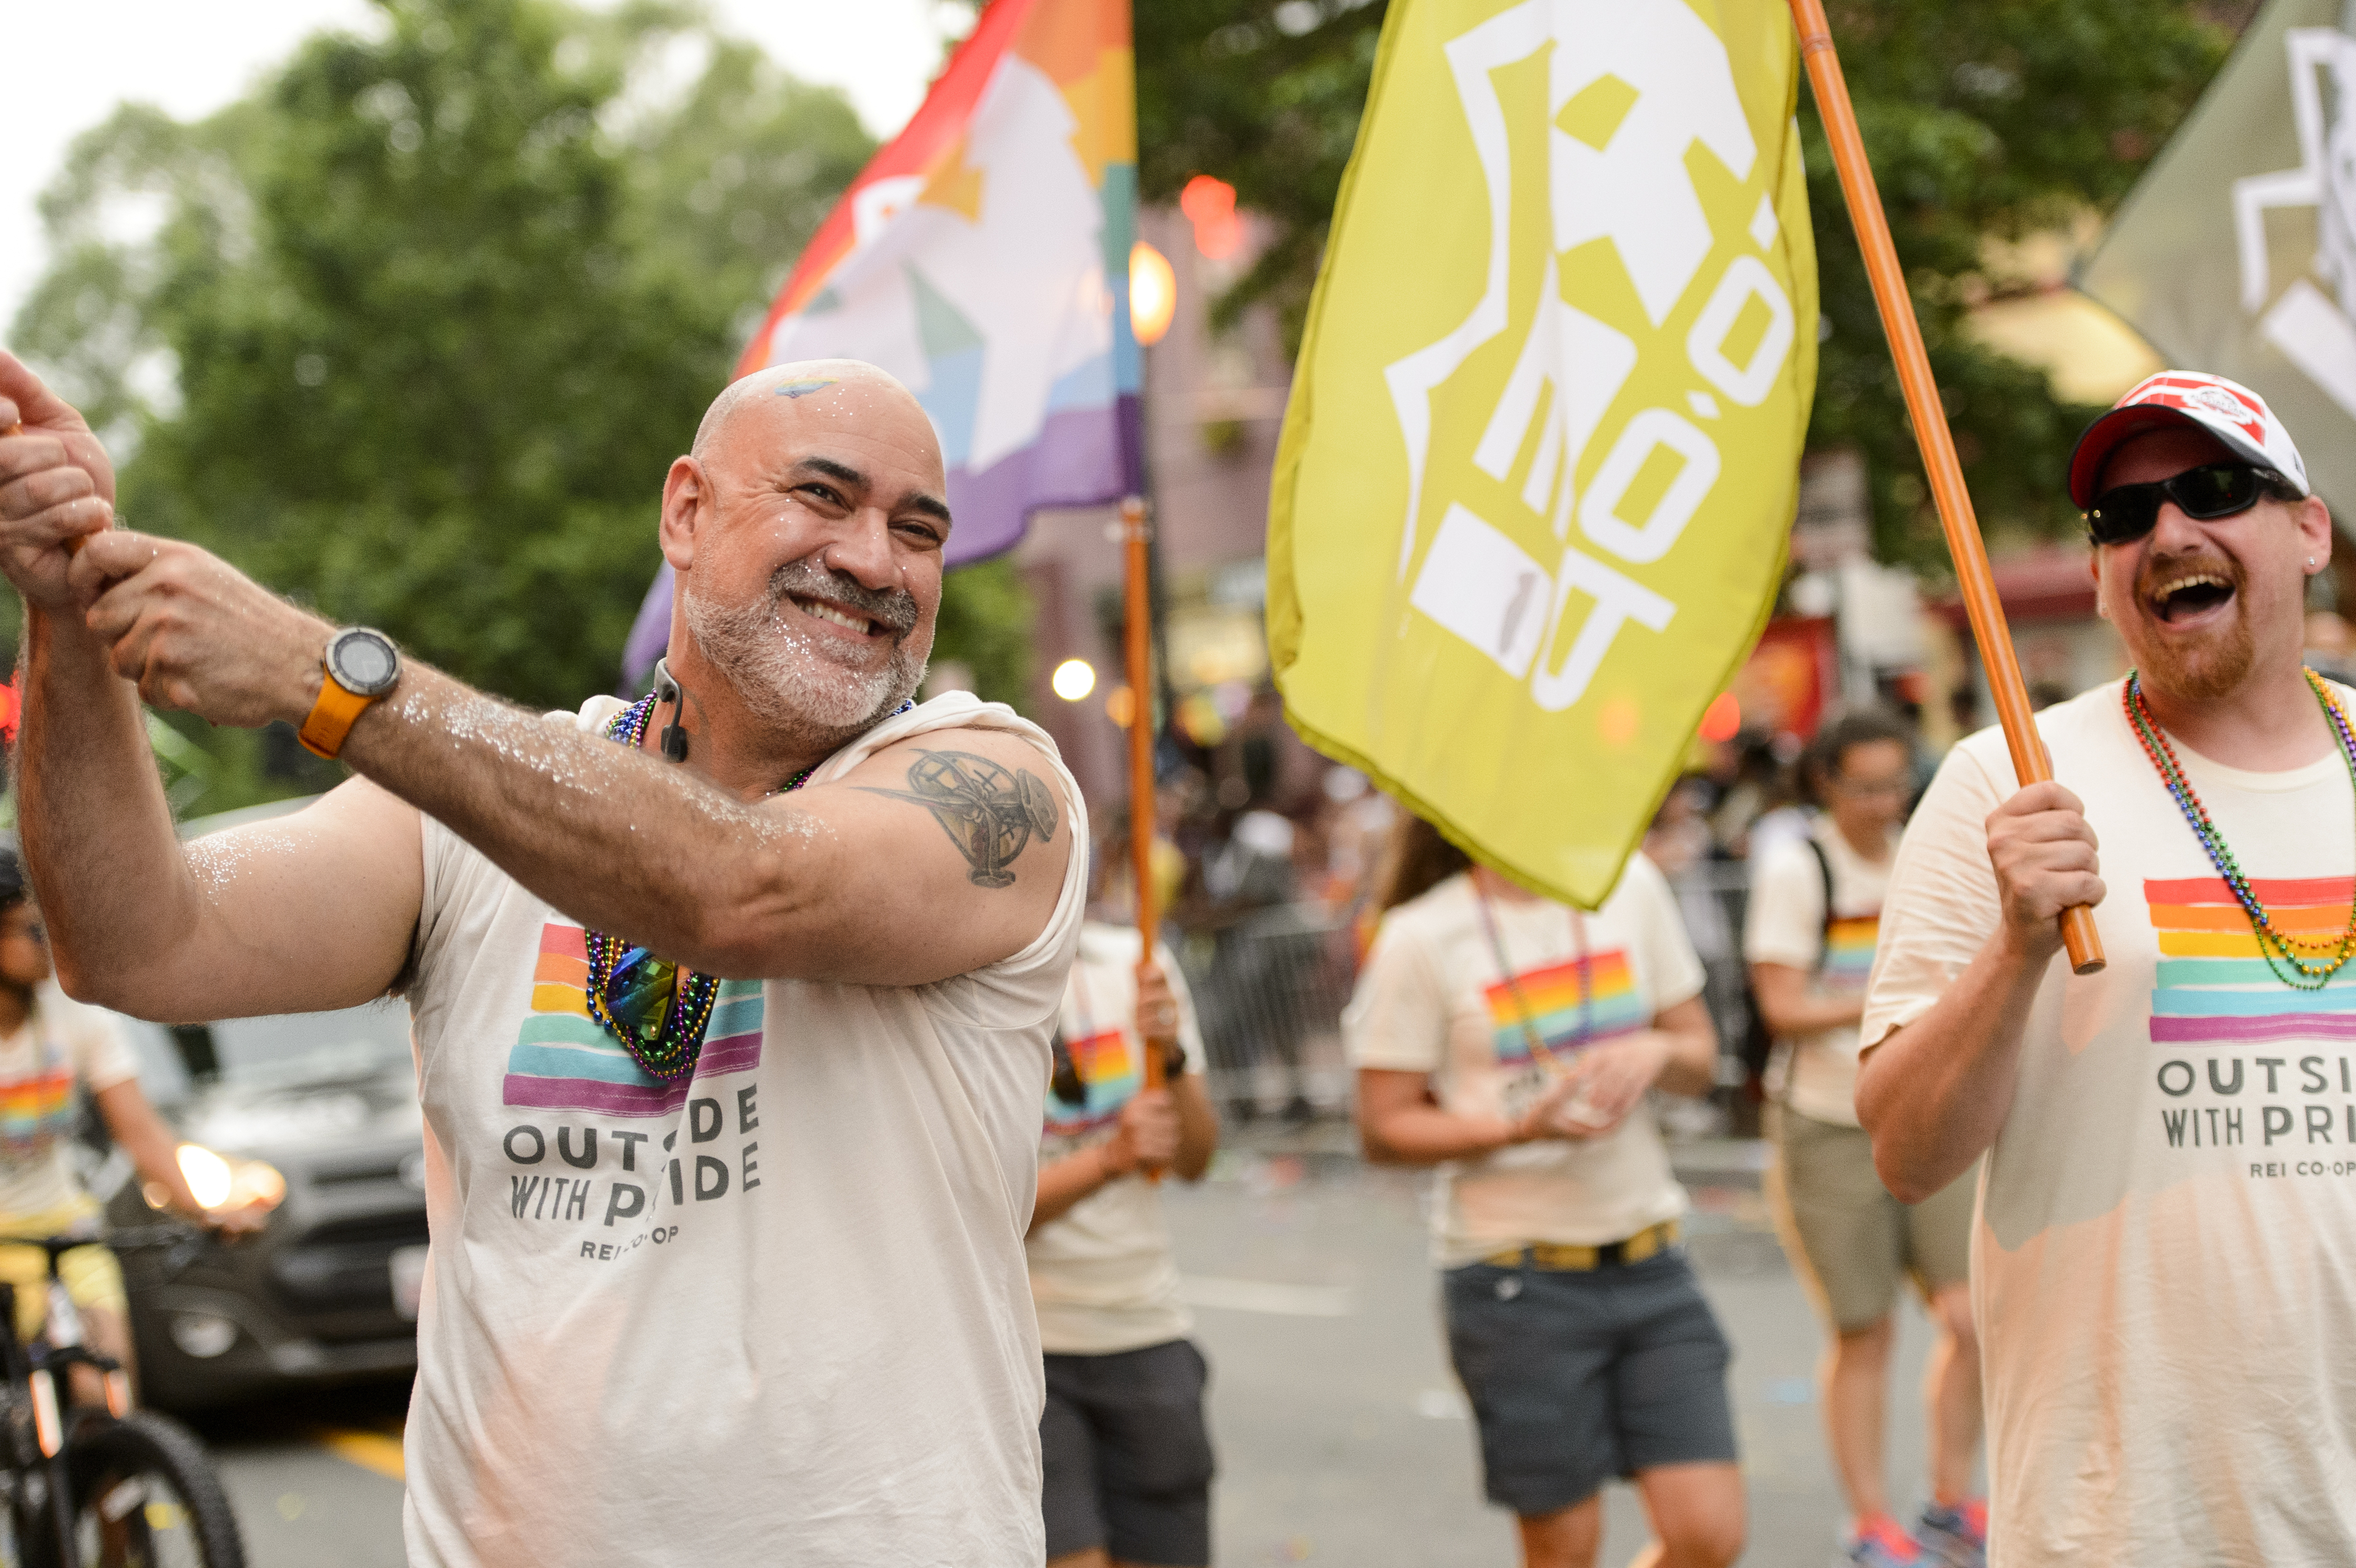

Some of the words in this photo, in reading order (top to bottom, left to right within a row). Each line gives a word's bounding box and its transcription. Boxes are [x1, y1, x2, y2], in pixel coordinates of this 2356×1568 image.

[2158, 1055, 2352, 1097] OUTSI
[503, 1083, 759, 1171] OUTDE
[2162, 1107, 2244, 1148] WITH
[511, 1175, 591, 1221] WITH
[603, 1141, 761, 1227] PIDE
[2250, 1162, 2286, 1178] REI
[580, 1240, 622, 1261] REI
